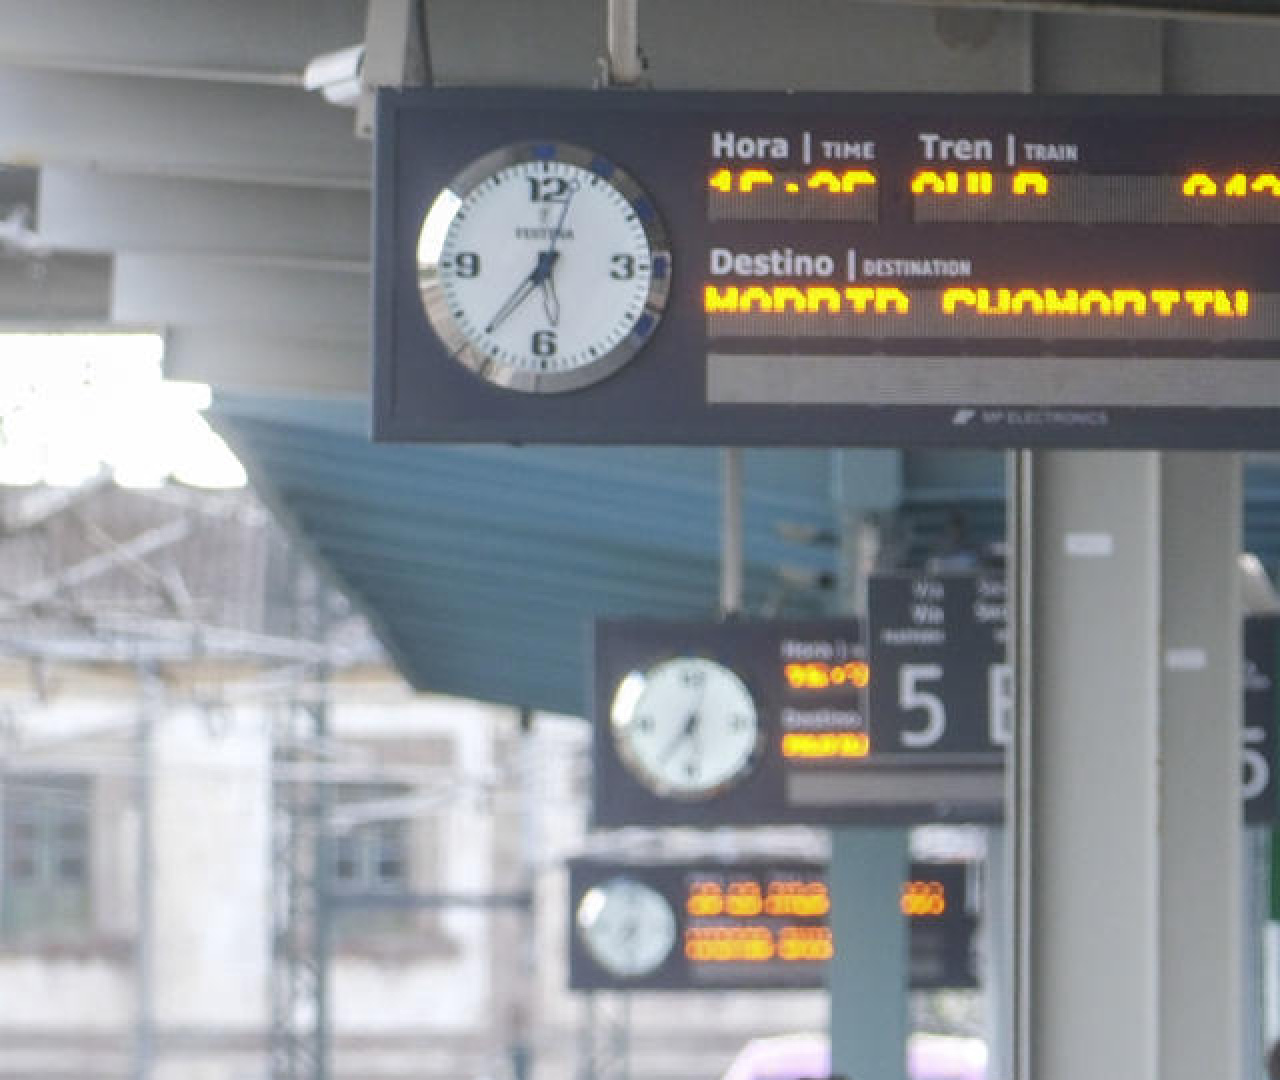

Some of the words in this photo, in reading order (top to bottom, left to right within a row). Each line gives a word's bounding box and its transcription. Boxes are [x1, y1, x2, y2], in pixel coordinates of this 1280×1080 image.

[711, 131, 788, 158] Hora
[821, 141, 876, 159] TIME
[918, 133, 993, 160] Tren
[1024, 143, 1079, 161] TRAIN
[528, 176, 571, 202] 12
[456, 252, 481, 278] 9
[610, 254, 635, 279] 3
[711, 248, 834, 276] Destino
[863, 259, 971, 276] DESTINATION
[531, 330, 557, 356] 6
[899, 664, 946, 747] 5
